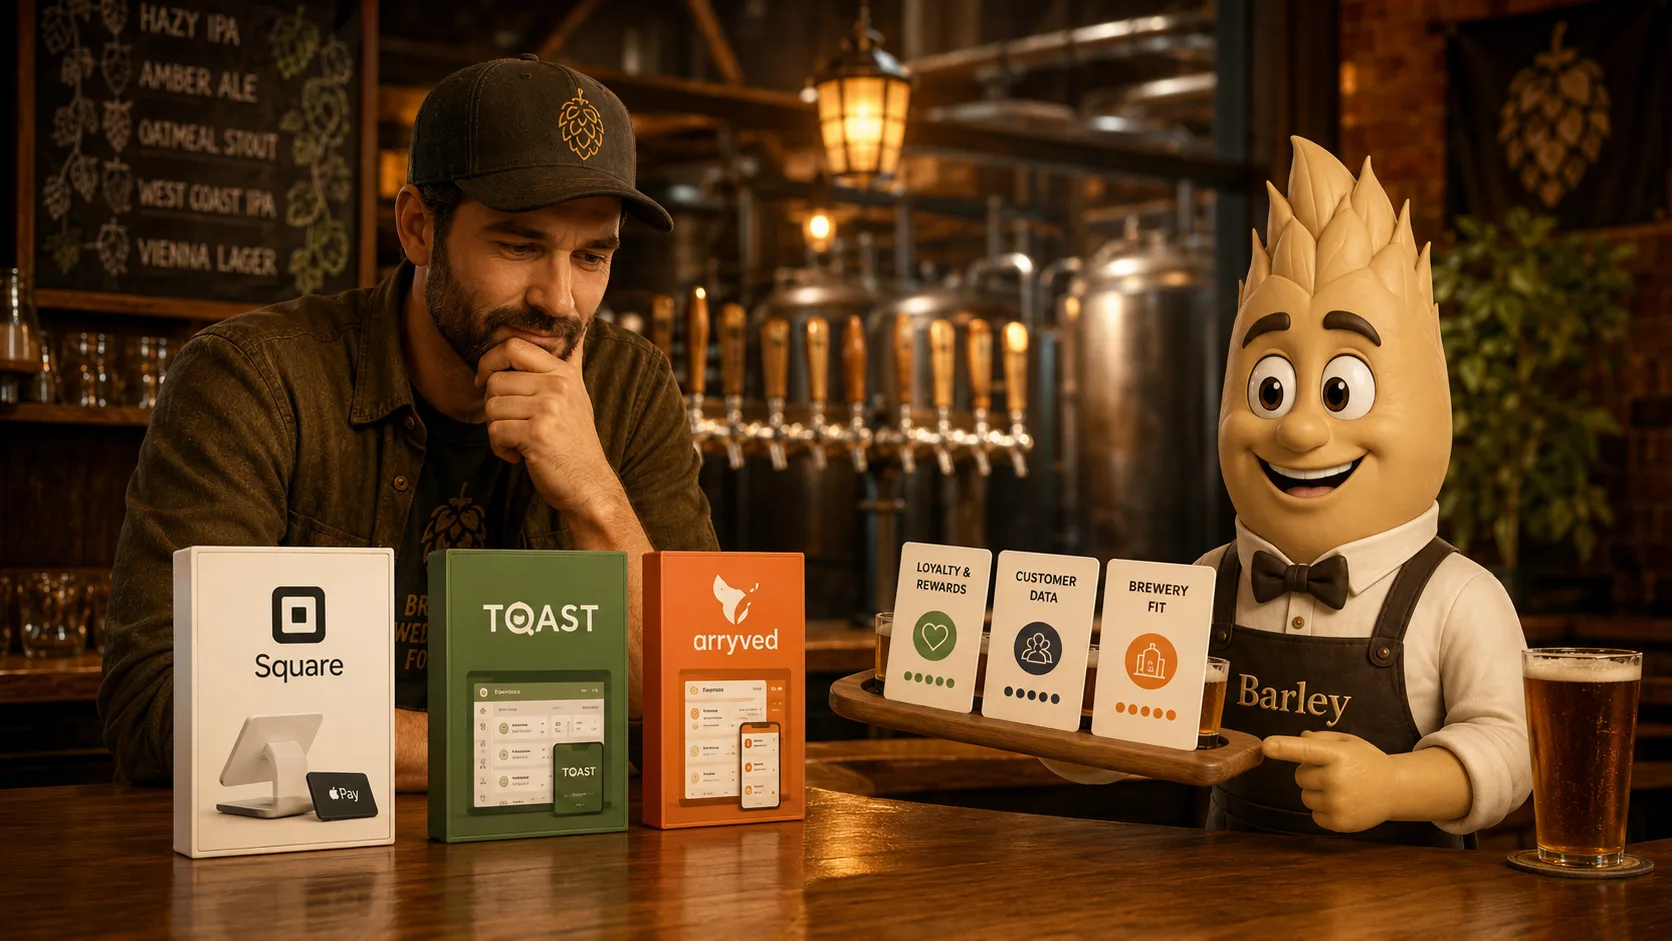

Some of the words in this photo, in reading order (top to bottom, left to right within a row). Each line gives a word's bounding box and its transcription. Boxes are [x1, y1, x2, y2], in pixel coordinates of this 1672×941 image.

[139, 2, 199, 39] HAZY
[206, 14, 241, 46] IPA
[139, 61, 211, 97] AMBER
[217, 71, 259, 103] ALE
[139, 118, 218, 153] OATMEAL
[223, 128, 280, 161] STOUT
[138, 180, 185, 208] WEST
[188, 184, 243, 215] COAST
[246, 192, 277, 219] IPA
[138, 238, 212, 271] VIENNA
[216, 246, 278, 276] LAGER
[916, 562, 961, 577] LOYALTY
[963, 567, 971, 578] &
[1015, 571, 1076, 587] CUSTOMER
[916, 579, 967, 594] REWARDS
[1030, 589, 1058, 603] DATA
[1128, 580, 1189, 597] BREWERY
[1147, 600, 1167, 613] FIT
[693, 628, 779, 655] arryved
[255, 653, 344, 683] Square
[1237, 673, 1352, 728] Barley
[562, 766, 596, 778] TOAST
[339, 787, 359, 802] Pay
